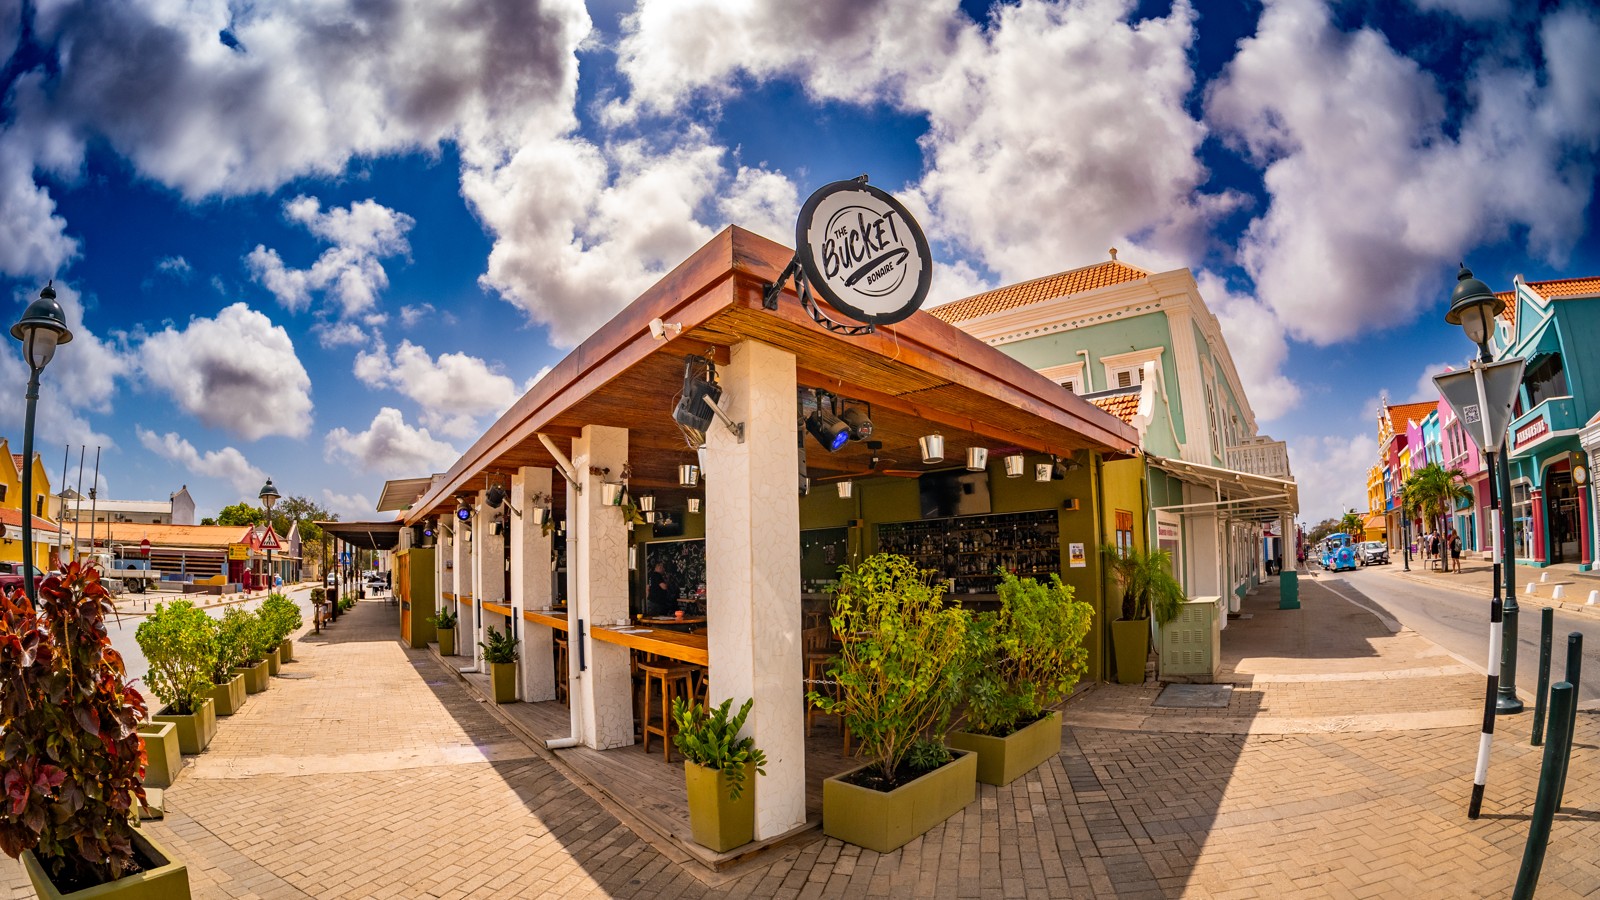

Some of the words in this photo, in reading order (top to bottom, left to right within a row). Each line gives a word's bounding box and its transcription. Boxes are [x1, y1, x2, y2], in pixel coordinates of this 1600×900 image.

[834, 226, 848, 239] THE
[822, 210, 898, 280] BUCKET
[867, 262, 894, 285] BONAIRE
